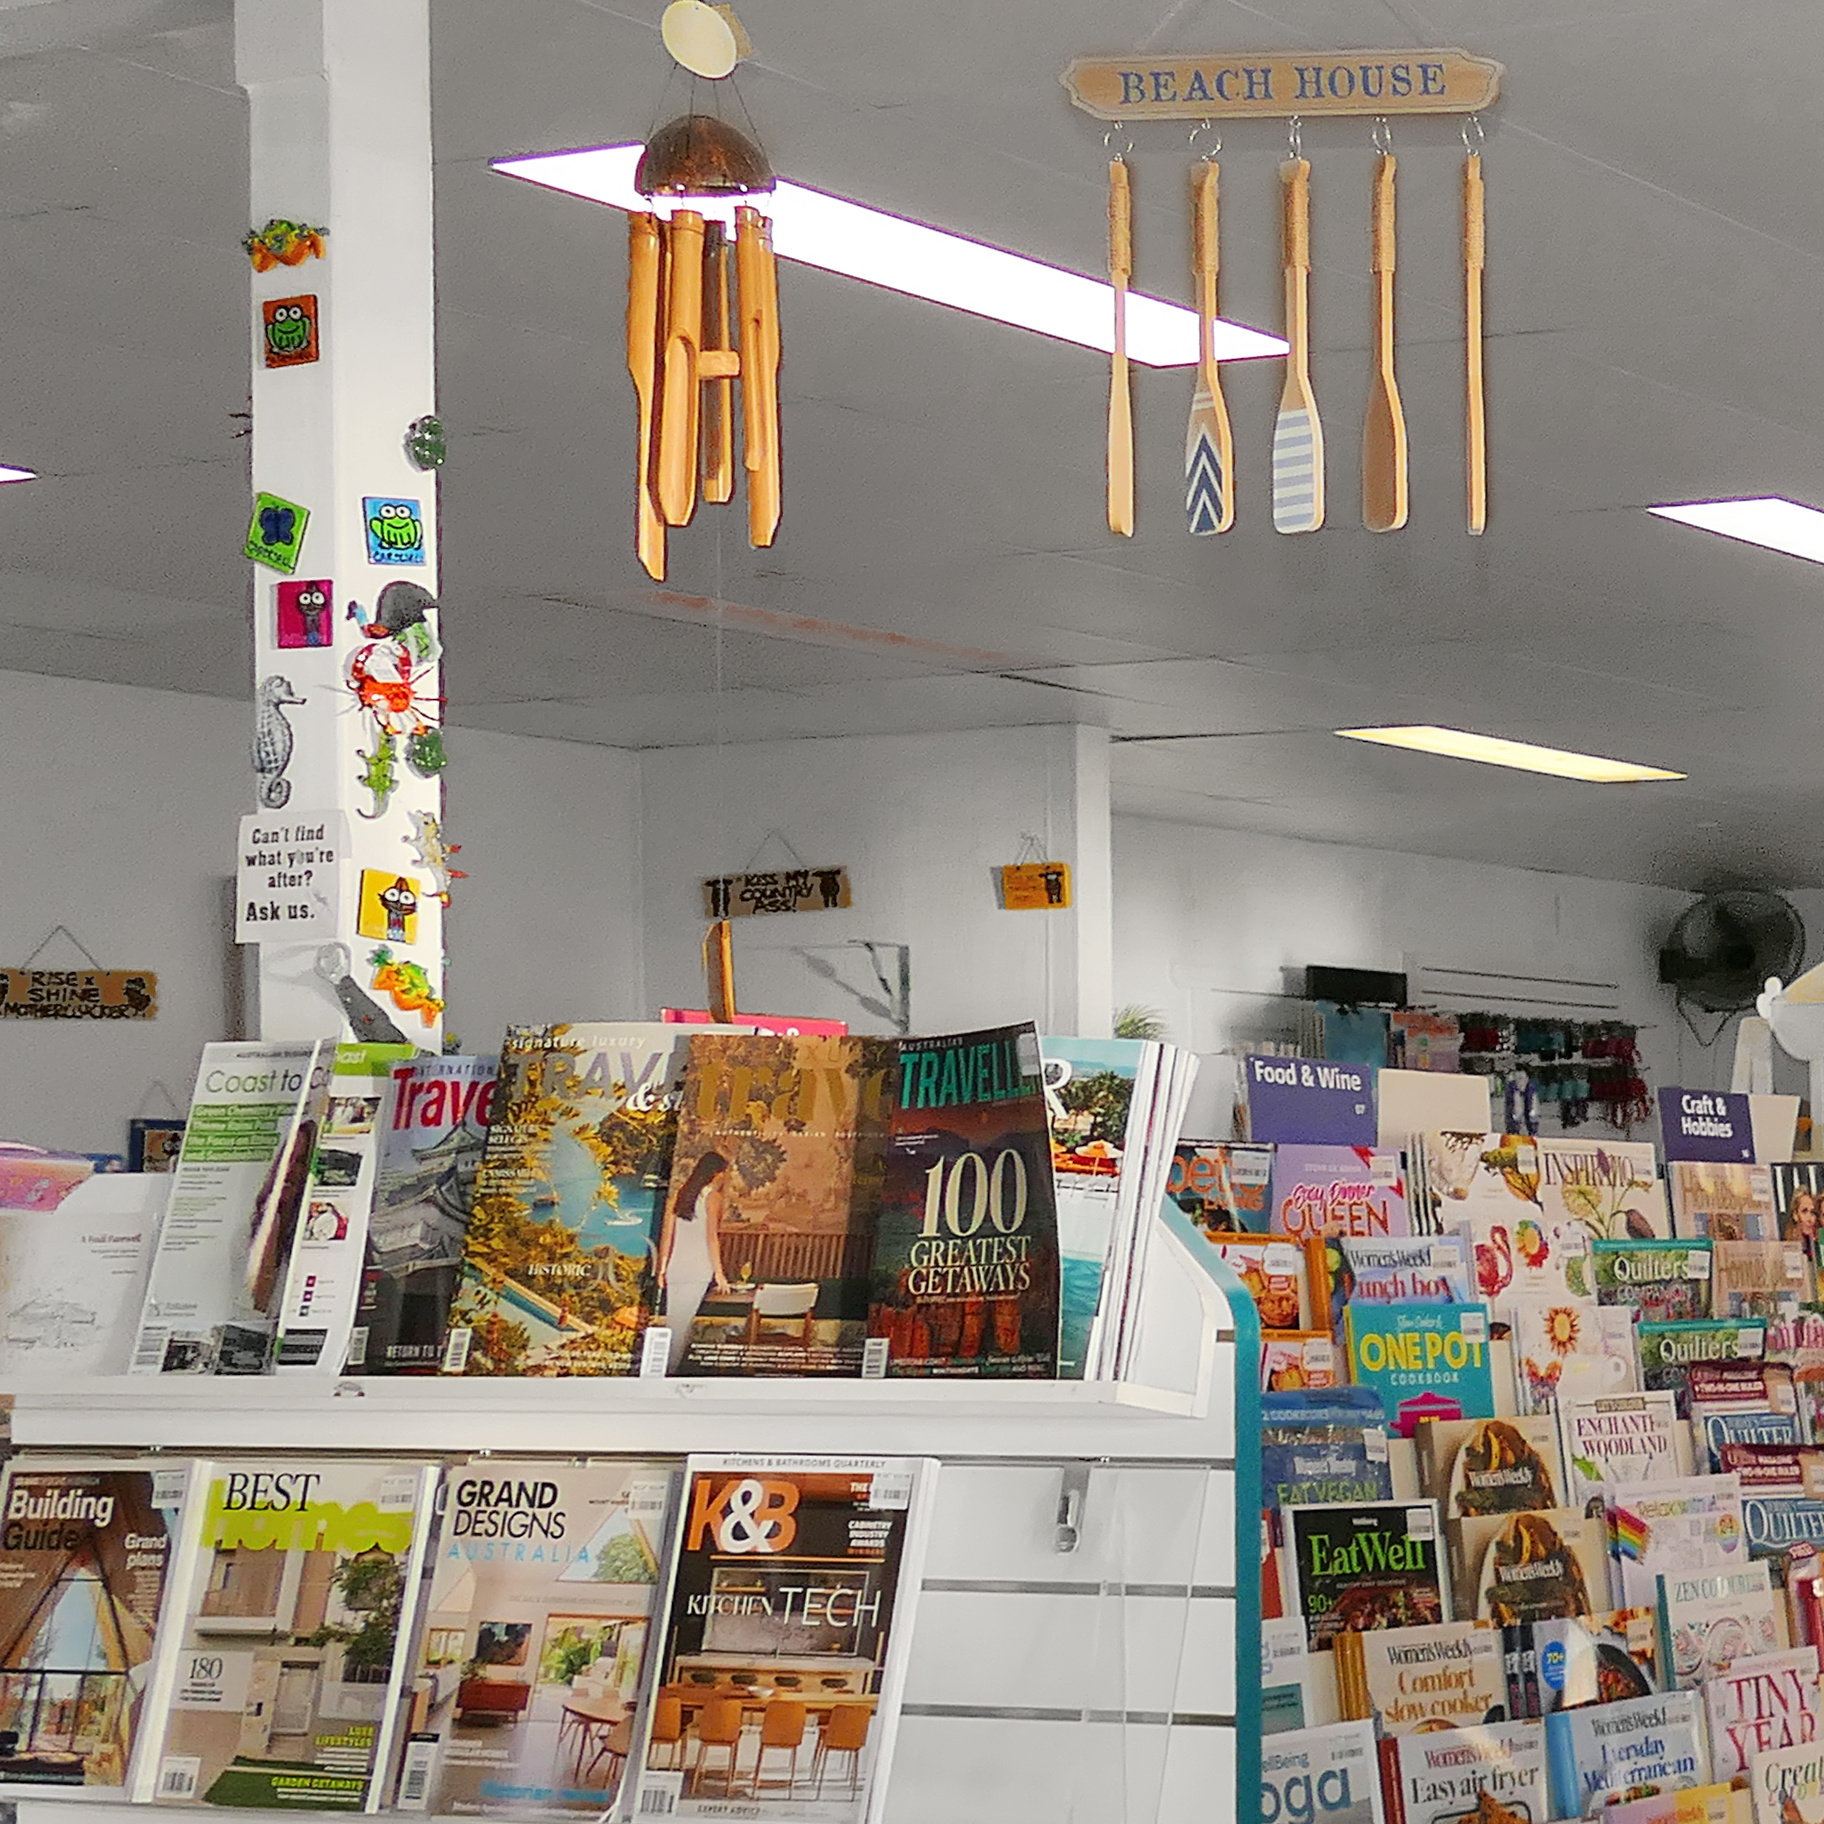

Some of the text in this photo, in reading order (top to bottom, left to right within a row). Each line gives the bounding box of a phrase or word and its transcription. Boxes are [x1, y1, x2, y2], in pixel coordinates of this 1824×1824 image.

[1119, 62, 1447, 105] BEACH HOUSE
[252, 824, 325, 845] Can't find
[245, 850, 282, 867] what
[268, 869, 314, 889] after?
[245, 901, 315, 922] Ask us.
[31, 970, 78, 987] RISE
[27, 987, 101, 1003] SHINE
[204, 1069, 304, 1094] Coast to
[1253, 1060, 1363, 1092] Food & Wine
[1681, 1095, 1713, 1117] Craft
[1681, 1115, 1734, 1139] Hobbies
[917, 1149, 1028, 1238] 100
[909, 1234, 1031, 1268] GREATEST
[907, 1263, 1031, 1296] GETAWAYS
[1359, 1333, 1427, 1372] ONE
[1390, 1370, 1460, 1386] COOKBOOK
[7, 1489, 114, 1527] Building
[223, 1473, 321, 1512] BEST
[455, 1477, 558, 1514] GRAND
[452, 1510, 565, 1541] DESIGNS
[687, 1479, 801, 1554] K&B
[447, 1542, 591, 1565] AUSTRALIA
[1308, 1526, 1425, 1578] EatWell
[686, 1587, 883, 1629] KITCHEN TECH
